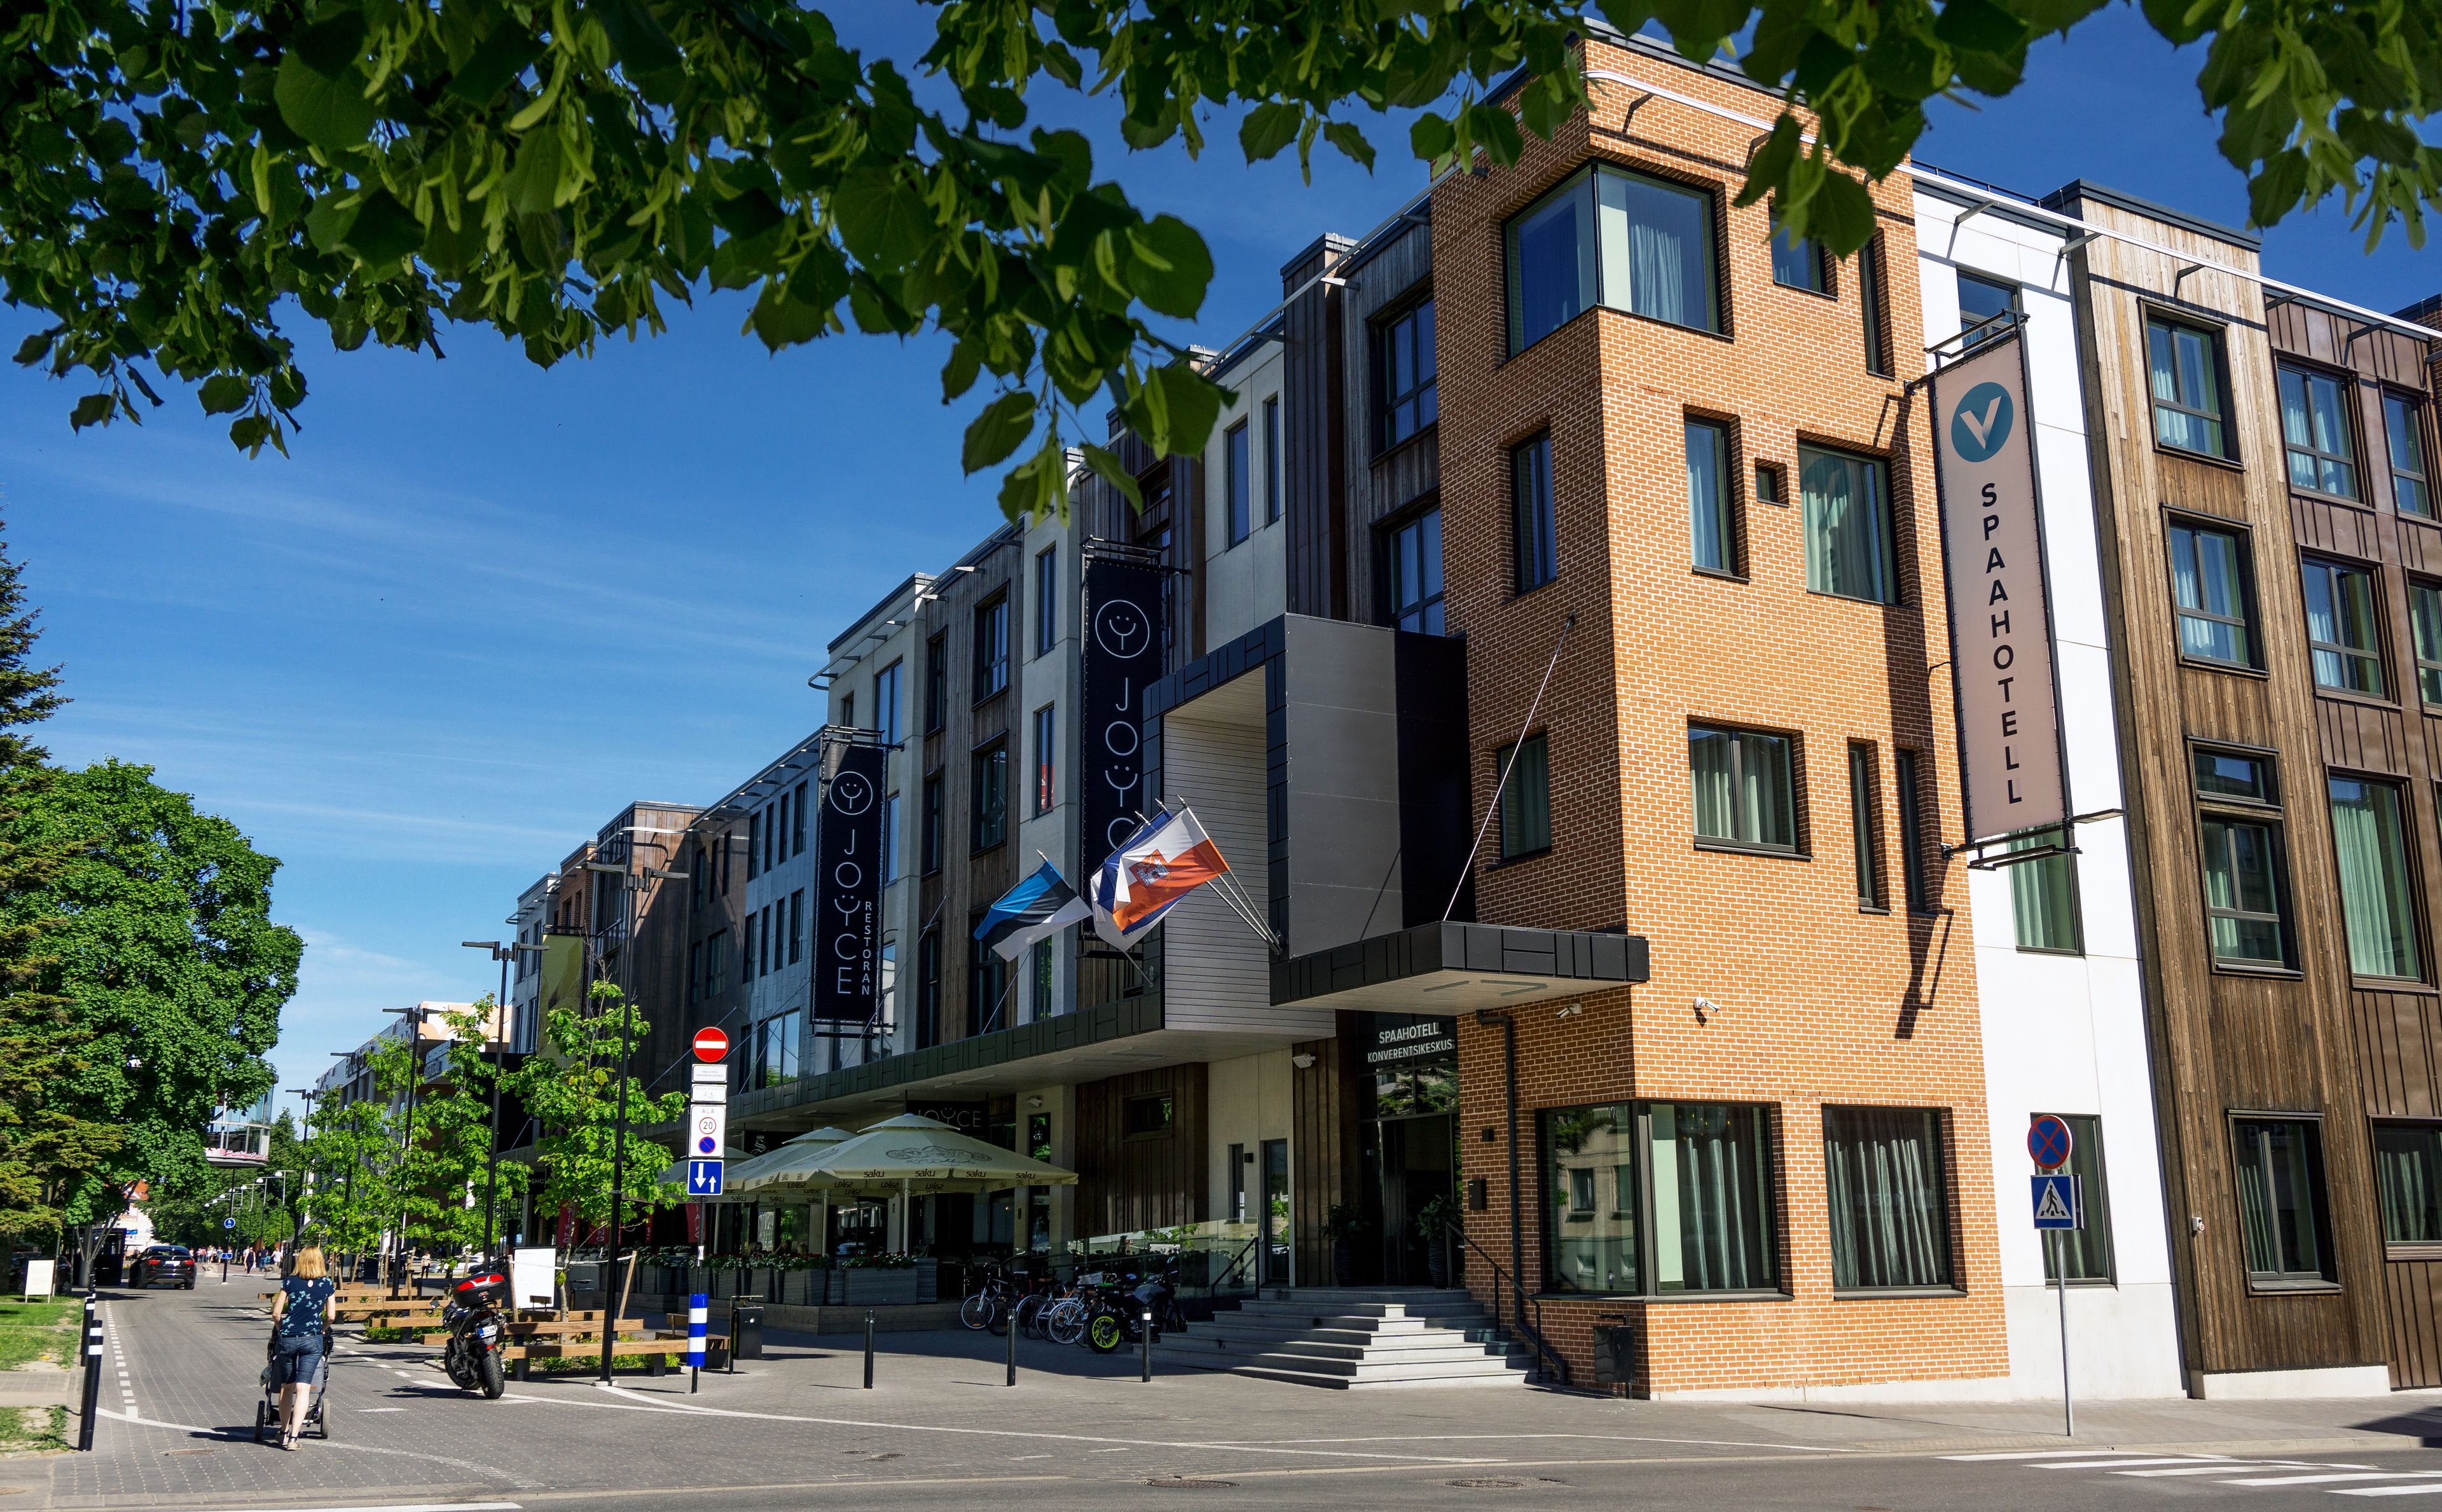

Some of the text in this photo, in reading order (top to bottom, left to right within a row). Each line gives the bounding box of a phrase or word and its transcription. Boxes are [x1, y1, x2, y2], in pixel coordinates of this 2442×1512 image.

[1980, 481, 2023, 806] SPAAHOTELL
[861, 900, 873, 996] RESTORAN
[1379, 1022, 1439, 1044] SPAAHOTELL
[1367, 1039, 1453, 1063] KONVERENTSIKESKUS
[703, 1122, 713, 1130] 20
[864, 1169, 885, 1178] saku
[915, 1168, 936, 1178] saku
[966, 1169, 986, 1178] saku
[1016, 1171, 1036, 1179] saku
